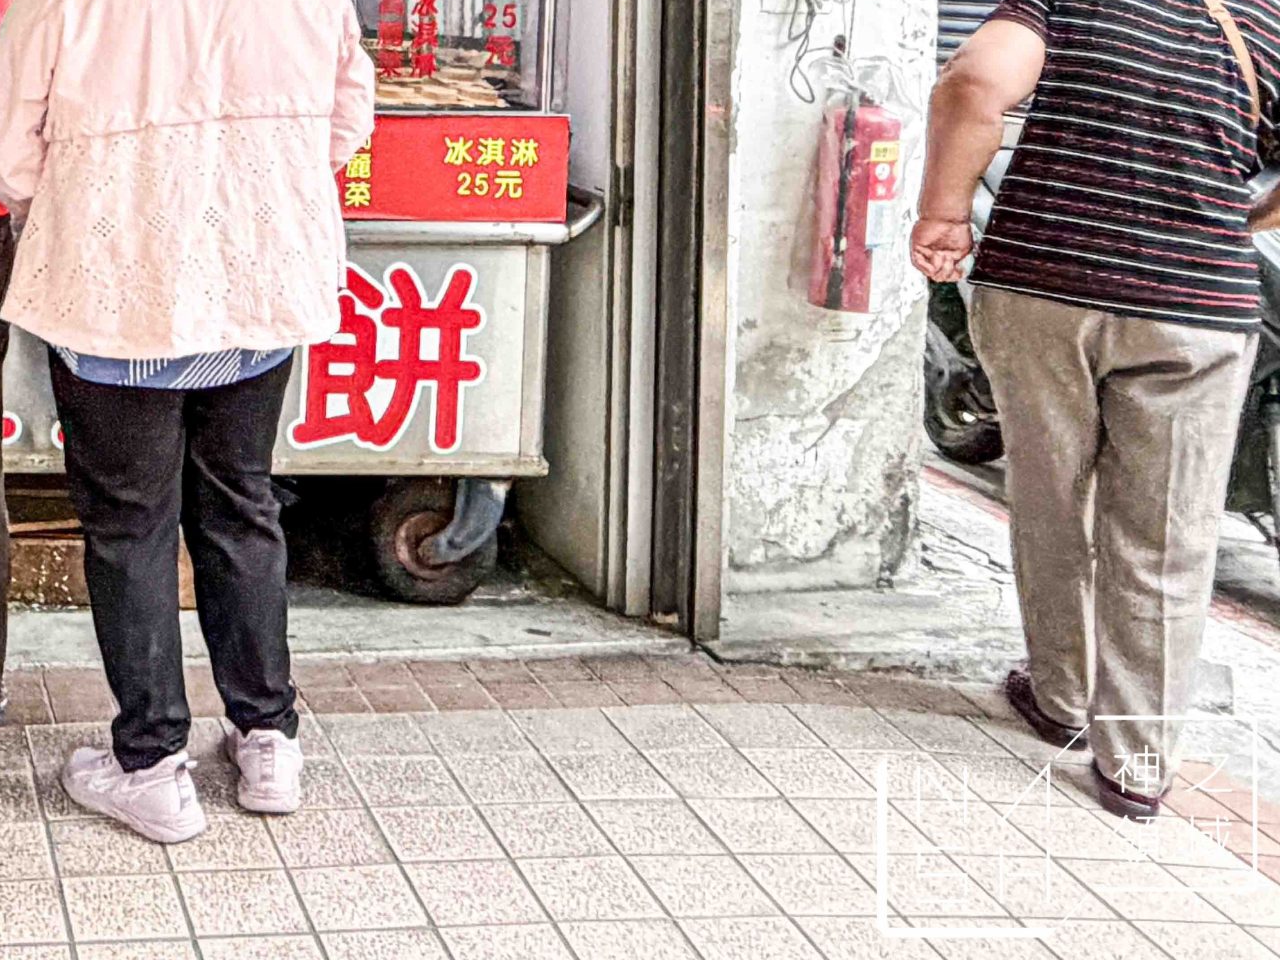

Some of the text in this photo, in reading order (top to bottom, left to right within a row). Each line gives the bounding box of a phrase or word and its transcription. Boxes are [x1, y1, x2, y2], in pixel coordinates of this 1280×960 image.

[443, 136, 539, 166] 冰淇淋
[344, 136, 372, 208] 麗菜
[457, 170, 524, 199] 25元
